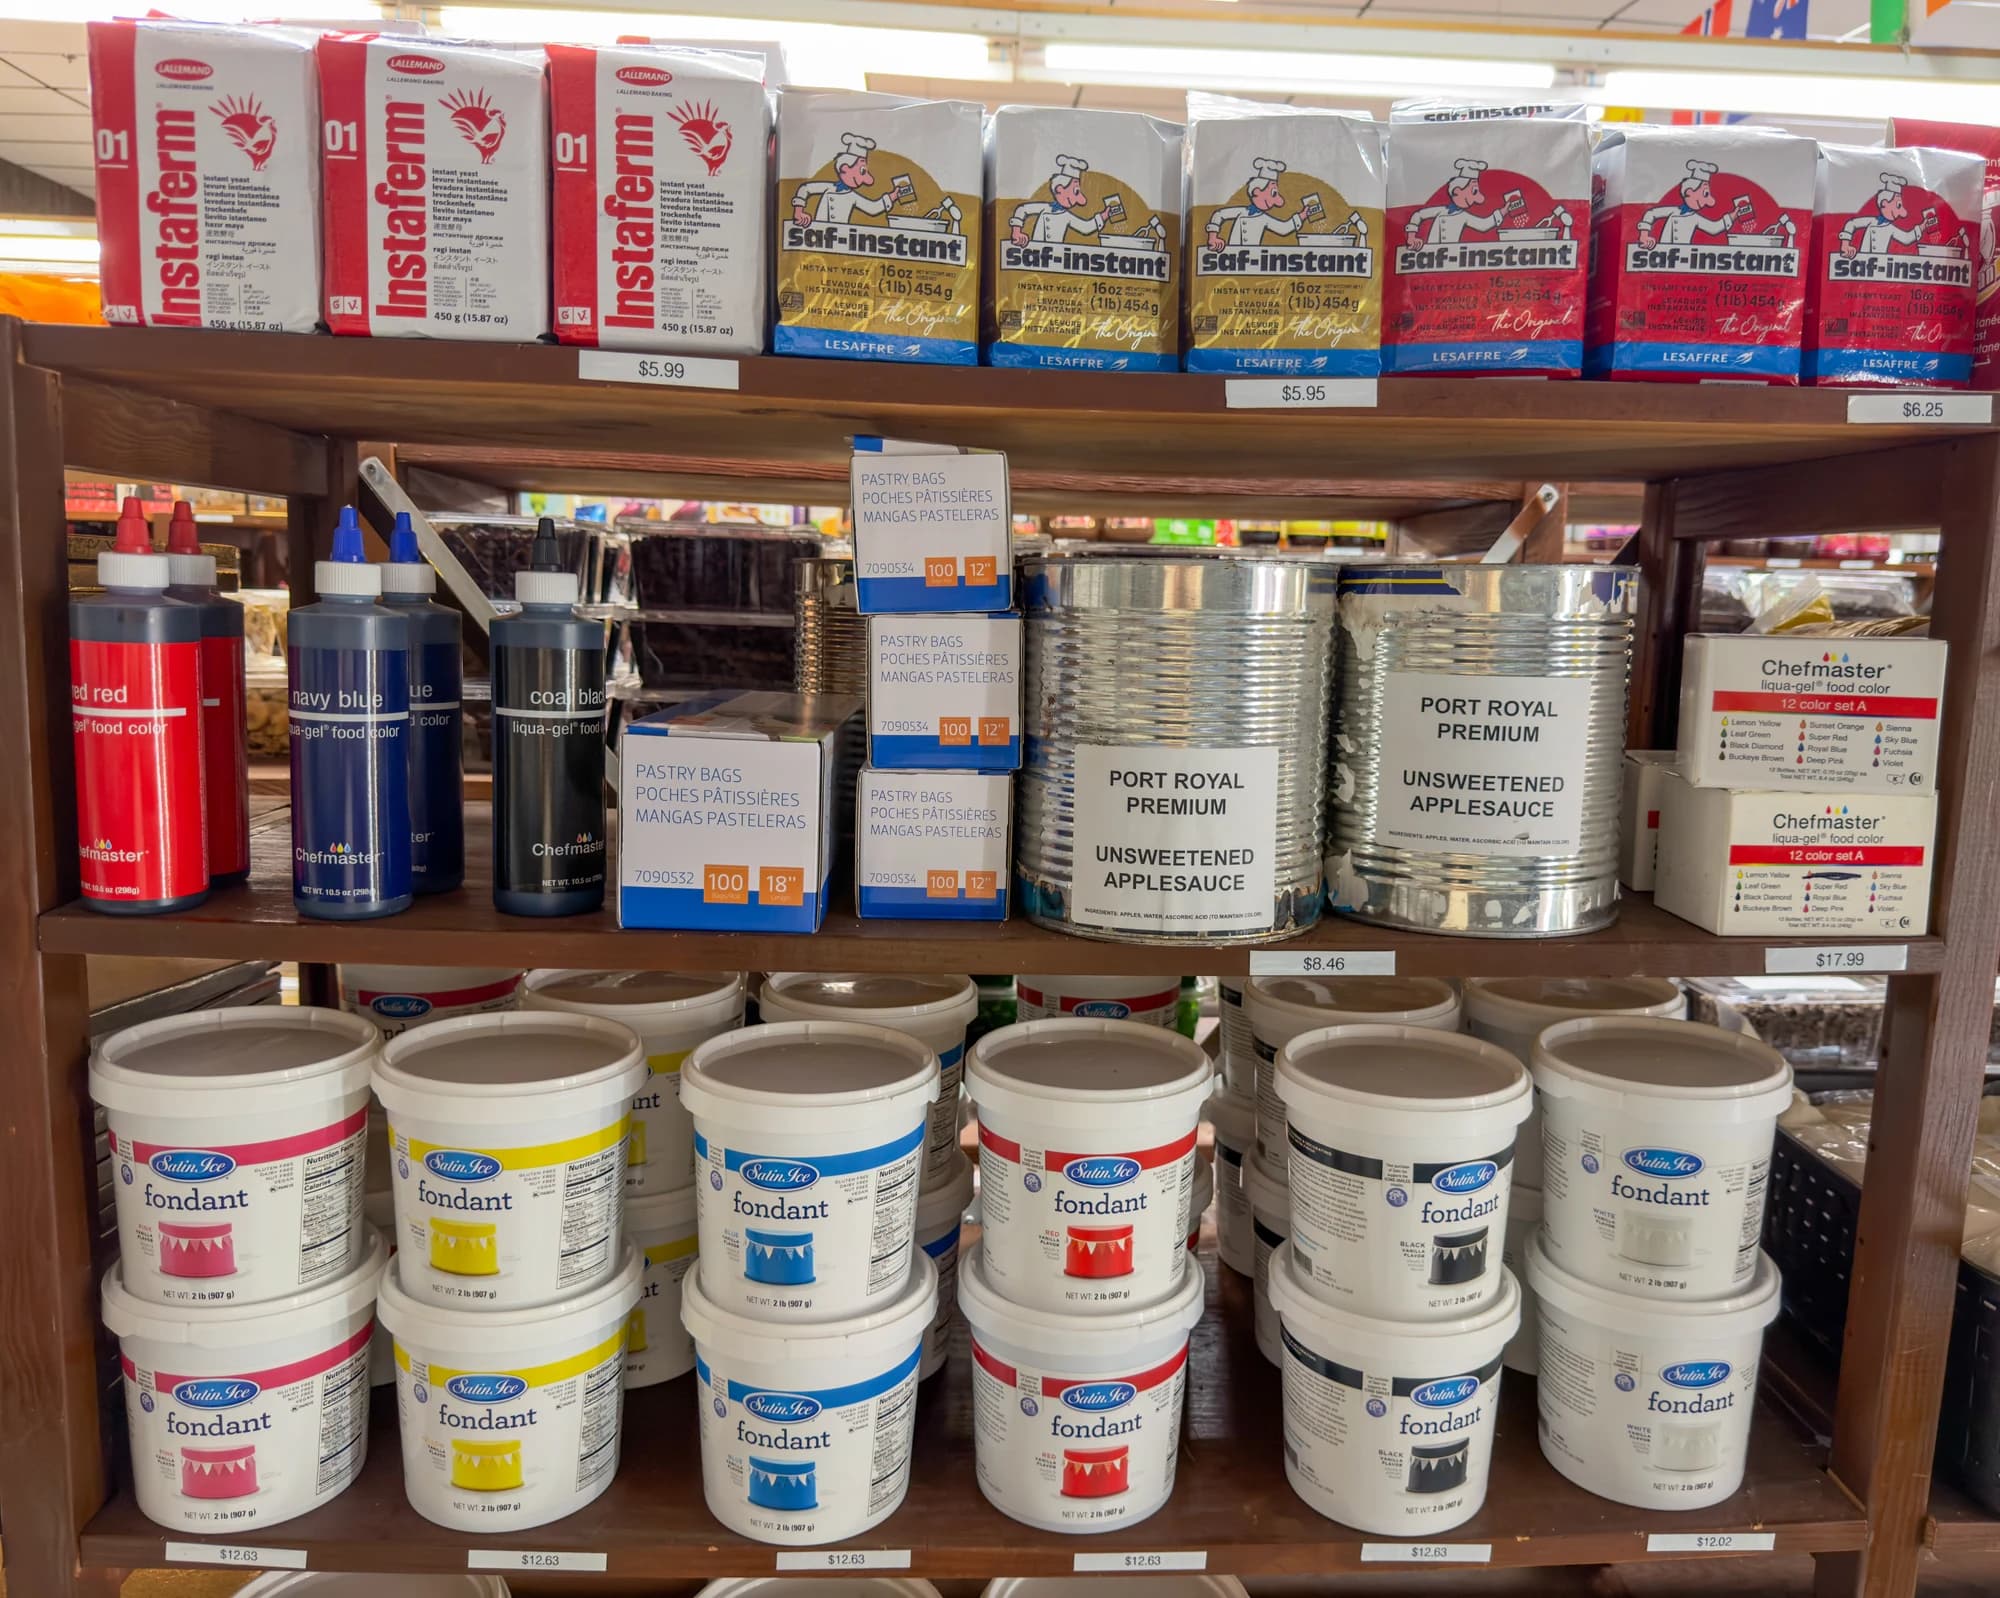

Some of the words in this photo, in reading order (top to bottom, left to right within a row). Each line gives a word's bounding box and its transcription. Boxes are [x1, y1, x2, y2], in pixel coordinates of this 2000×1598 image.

[390, 58, 444, 72] LALLEMAND
[620, 71, 670, 81] LALLEMAND
[325, 120, 357, 152] 01
[97, 129, 128, 160] 01
[556, 133, 587, 164] 01
[661, 180, 684, 188] instant
[146, 109, 202, 327] Instaferm
[374, 103, 427, 319] Instaferm
[661, 211, 701, 219] trockenhefe
[604, 115, 654, 329] Instaferm
[787, 226, 963, 262] saf-instant
[1006, 246, 1166, 278] saf-instant
[1202, 250, 1368, 273] saf-instant
[1400, 245, 1572, 270] saf-instant
[1632, 248, 1796, 274] saf-instant
[1834, 258, 1970, 284] saf-instant
[1323, 297, 1349, 309] 454
[662, 323, 678, 331] 450
[681, 325, 687, 334] g
[690, 324, 717, 334] (15.87
[720, 326, 733, 336] oz)
[825, 339, 895, 355] LESAFFRE
[638, 360, 684, 378] $5.99
[1040, 356, 1104, 369] LESAFFRE
[1863, 358, 1918, 370] LESAFFRE
[1282, 386, 1325, 401] $5.95
[1903, 402, 1943, 417] $6.25
[862, 473, 910, 485] PASTRY
[912, 472, 946, 485] BAGS
[862, 491, 912, 504] POCHES
[916, 488, 992, 503] PÂTISSIÈRES
[864, 510, 917, 522] MANGAS
[920, 508, 999, 522] PASTELERAS
[866, 562, 914, 574] 7090534
[929, 564, 953, 576] 100
[1762, 660, 1885, 679] Chefmaster
[94, 685, 127, 703] red
[1827, 681, 1854, 693] food
[1858, 683, 1890, 694] color
[293, 691, 330, 710] navy
[339, 690, 383, 708] blue
[1421, 697, 1481, 715] PORT
[1488, 700, 1558, 717] ROYAL
[1782, 699, 1796, 709] 12
[1800, 699, 1831, 711] color
[1834, 701, 1854, 711] set
[1859, 702, 1867, 711] A
[92, 720, 122, 734] food
[128, 722, 168, 734] color
[580, 722, 600, 734] food
[1732, 719, 1754, 727] Lemon
[1756, 720, 1781, 728] Yellow
[1810, 722, 1835, 730] Sunset
[1838, 722, 1865, 732] Orange
[333, 726, 365, 739] food
[369, 726, 400, 738] color
[1437, 723, 1539, 742] PREMIUM
[1748, 731, 1771, 739] Green
[1809, 733, 1831, 742] Super
[1832, 734, 1848, 742] Red
[1730, 742, 1749, 750] Black
[1751, 743, 1784, 751] Diamond
[1885, 737, 1899, 745] Sky
[1808, 745, 1828, 754] Royal
[1807, 756, 1826, 765] Deep
[1828, 756, 1844, 764] Pink
[636, 764, 696, 781] PASTRY
[700, 768, 742, 783] BAGS
[1110, 771, 1167, 789] PORT
[1175, 773, 1245, 789] ROYAL
[1403, 770, 1565, 793] UNSWEETENED
[636, 786, 699, 803] POCHES
[704, 787, 800, 807] PÂTISSIÈRES
[1127, 797, 1226, 815] PREMIUM
[1410, 796, 1554, 817] APPLESAUCE
[636, 809, 703, 825] MANGAS
[707, 811, 806, 829] PASTELERAS
[1773, 814, 1880, 830] Chefmaster
[296, 848, 380, 864] Chefmaster
[1096, 845, 1254, 866] UNSWEETENED
[635, 870, 694, 884] 7090532
[709, 873, 743, 891] 100
[767, 875, 797, 893] 18"
[1104, 872, 1245, 892] APPLESAUCE
[1303, 956, 1345, 972] $8.46
[1816, 953, 1864, 967] $17.99
[156, 1155, 197, 1173] Satin
[199, 1154, 226, 1172] Ice
[1071, 1162, 1110, 1178] Satin
[1112, 1162, 1133, 1177] Ice
[746, 1164, 784, 1182] Satin
[787, 1167, 810, 1183] Ice
[145, 1184, 249, 1211] fondant
[419, 1180, 512, 1211] fondant
[1611, 1175, 1710, 1206] fondant
[733, 1190, 829, 1220] fondant
[1055, 1191, 1147, 1215] fondant
[1421, 1194, 1499, 1223] fondant
[163, 1290, 176, 1298] NET
[208, 1291, 225, 1300] (907
[227, 1290, 234, 1300] g)
[1647, 1391, 1735, 1414] fondant
[166, 1409, 272, 1436] fondant
[1051, 1414, 1142, 1439] fondant
[1696, 1535, 1732, 1549] $12.02
[220, 1548, 258, 1563] $12.63
[521, 1554, 560, 1567] $12.63
[828, 1553, 865, 1567] $12.63
[1411, 1546, 1448, 1559] $12.63
[1124, 1554, 1161, 1568] $12.63
